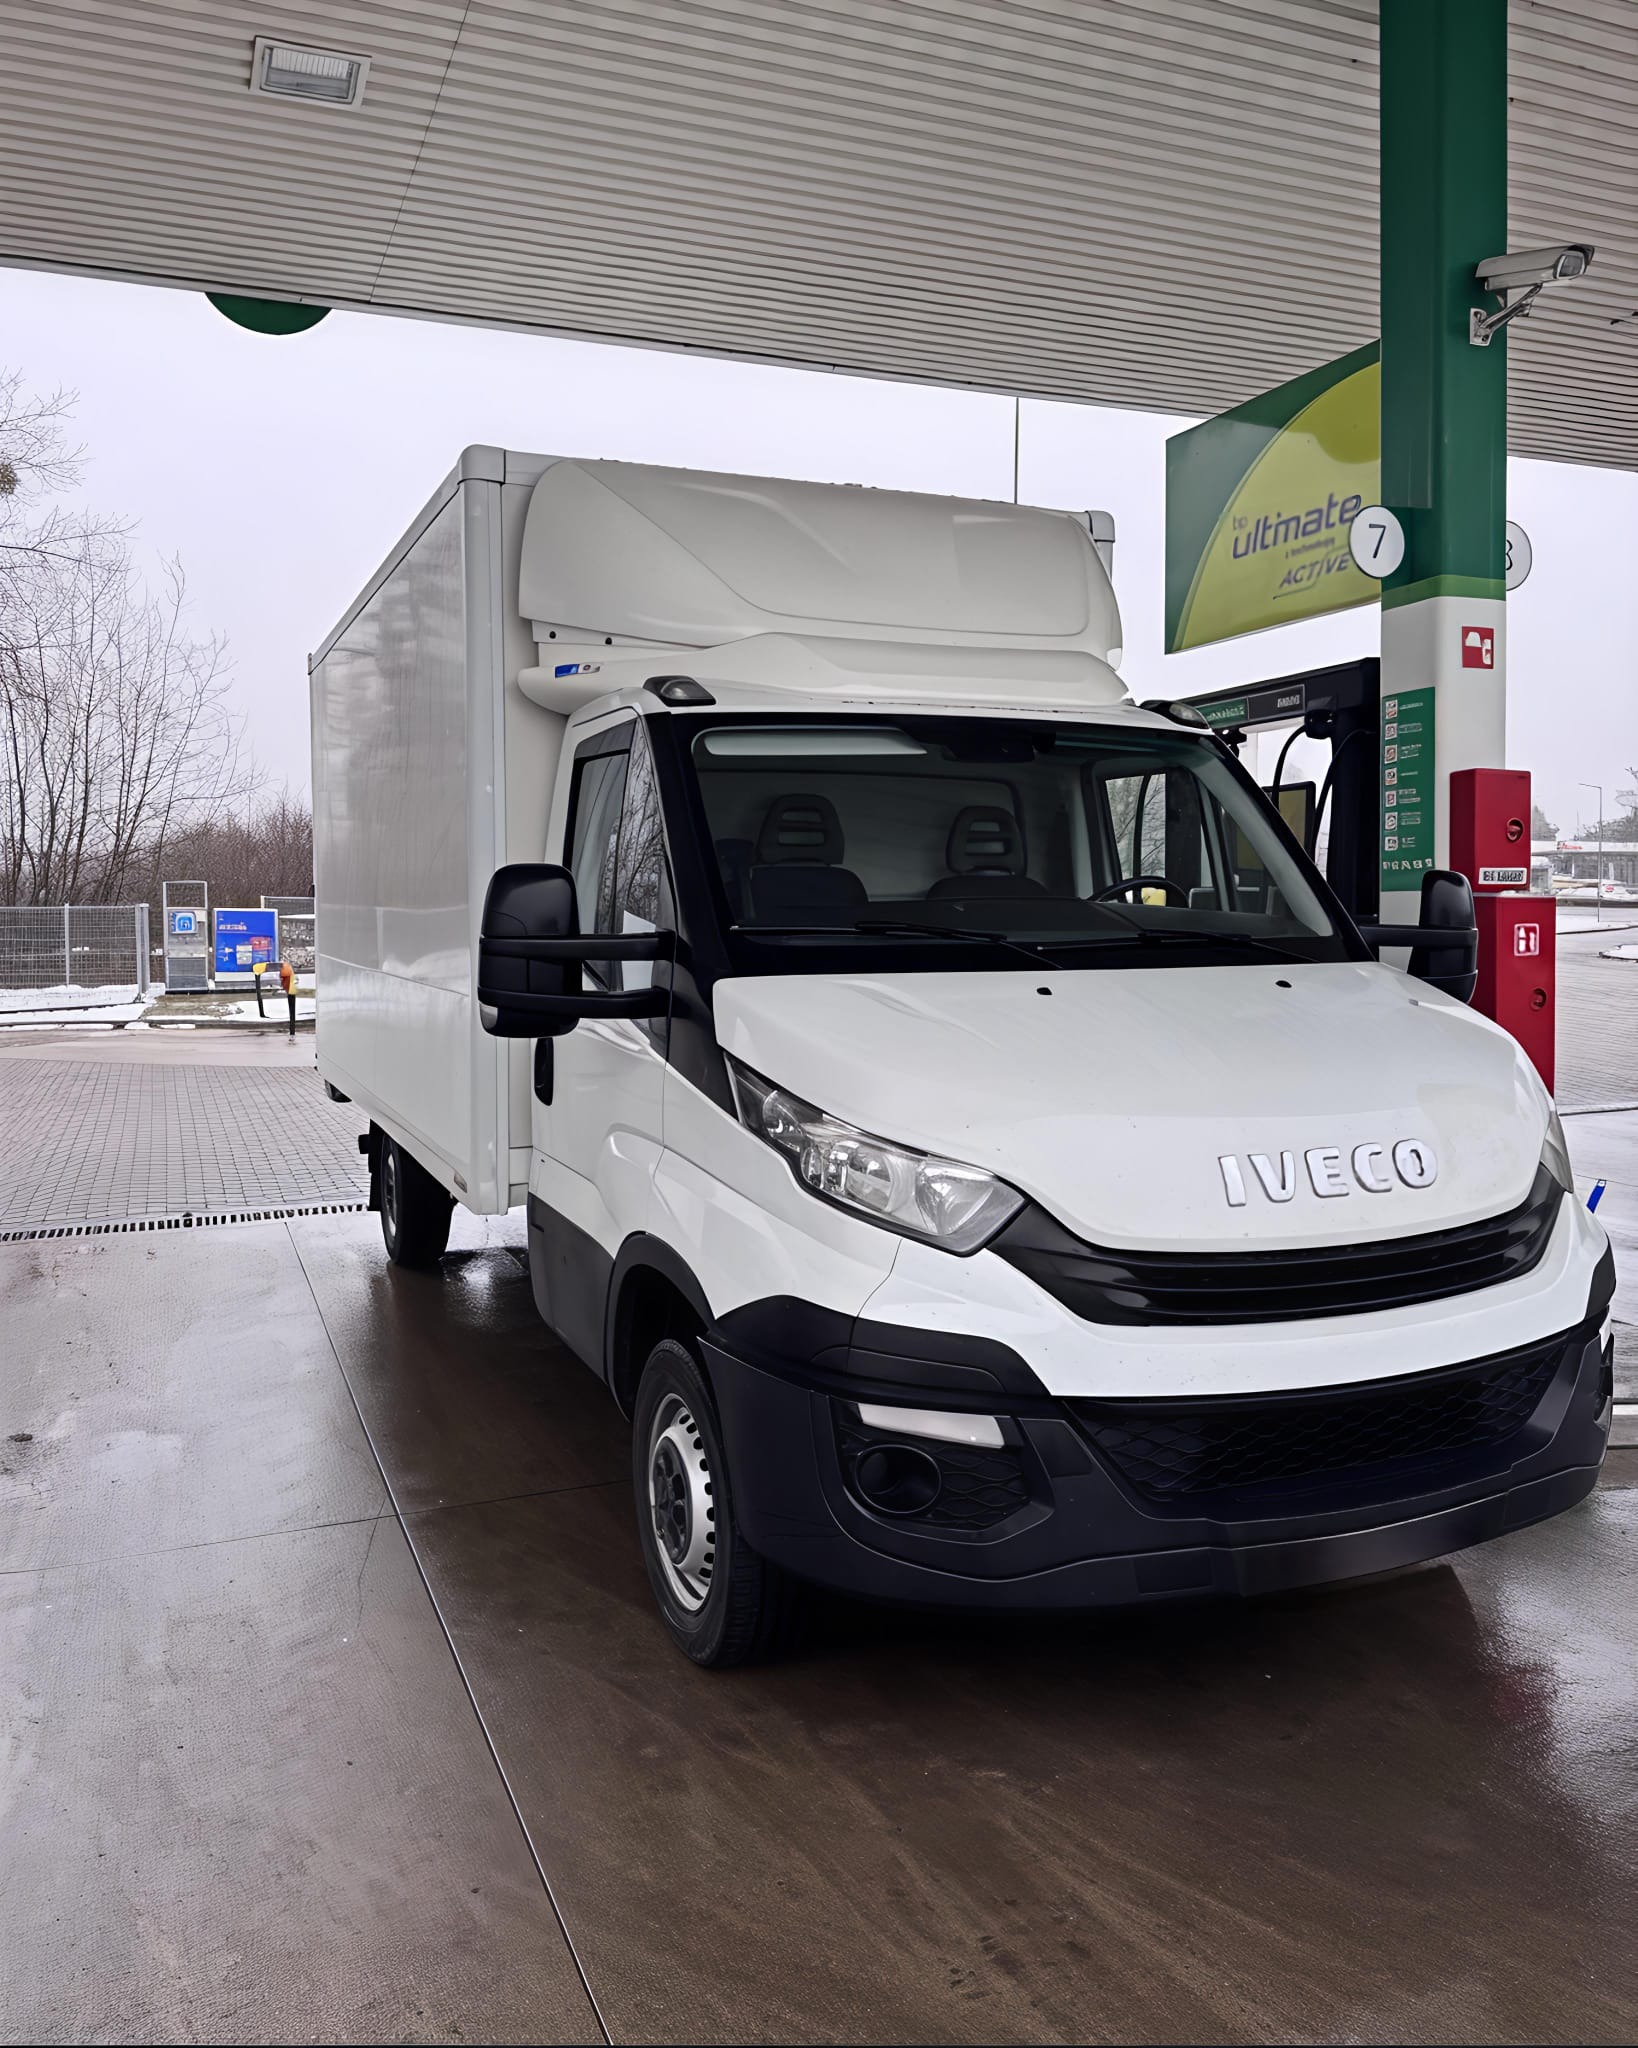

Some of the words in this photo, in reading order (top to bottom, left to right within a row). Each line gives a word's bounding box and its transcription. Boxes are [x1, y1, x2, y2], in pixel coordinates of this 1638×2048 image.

[1233, 493, 1361, 559] ultimate
[1368, 523, 1386, 559] 7
[1217, 1138, 1438, 1207] IVECO
